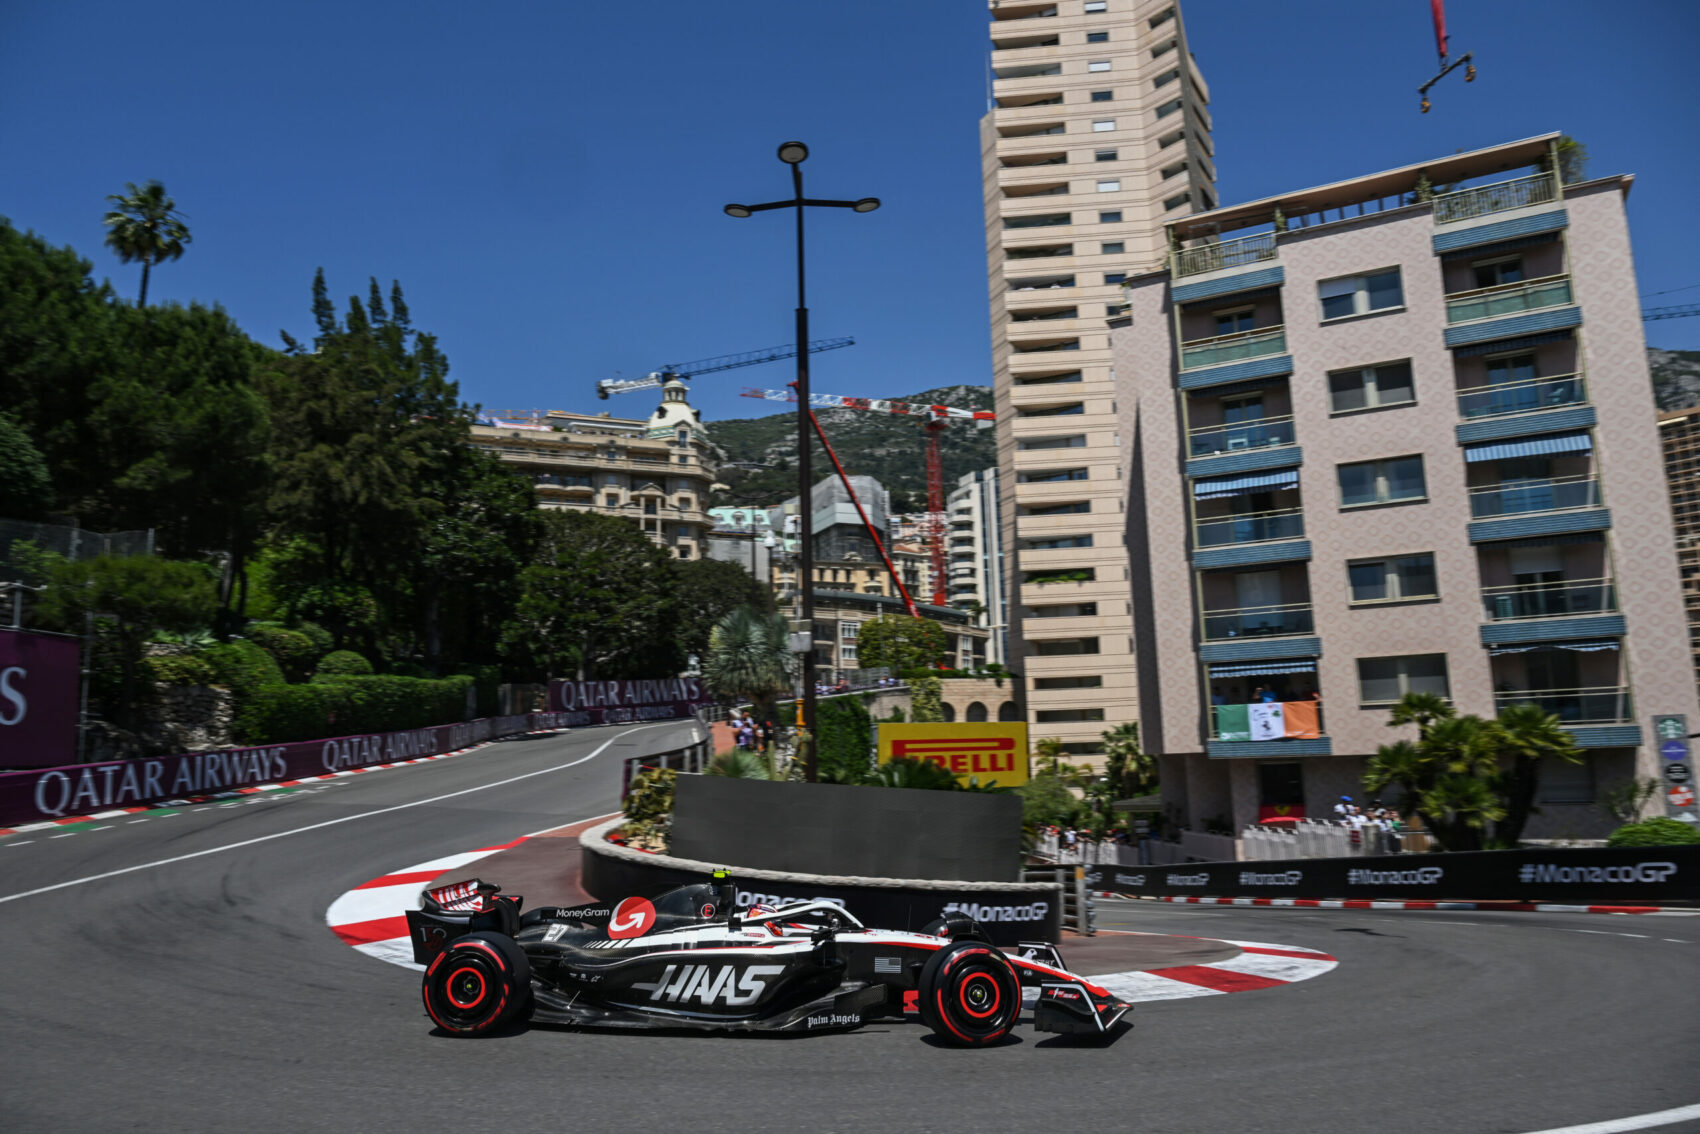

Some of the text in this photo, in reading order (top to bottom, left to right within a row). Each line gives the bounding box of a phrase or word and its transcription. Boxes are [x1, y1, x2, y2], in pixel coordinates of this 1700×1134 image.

[561, 677, 701, 711] QATAR AIRWAYS
[321, 735, 382, 772] QATAR
[383, 728, 440, 761] AIRWAYS
[35, 746, 287, 817] QATAR AIRWAYS
[1347, 867, 1443, 885] #MonacoGP
[1519, 862, 1677, 882] #MonacoGP
[556, 908, 610, 921] MoneyGram
[631, 965, 786, 1006] HAAS
[808, 1014, 860, 1028] Palm Angels
